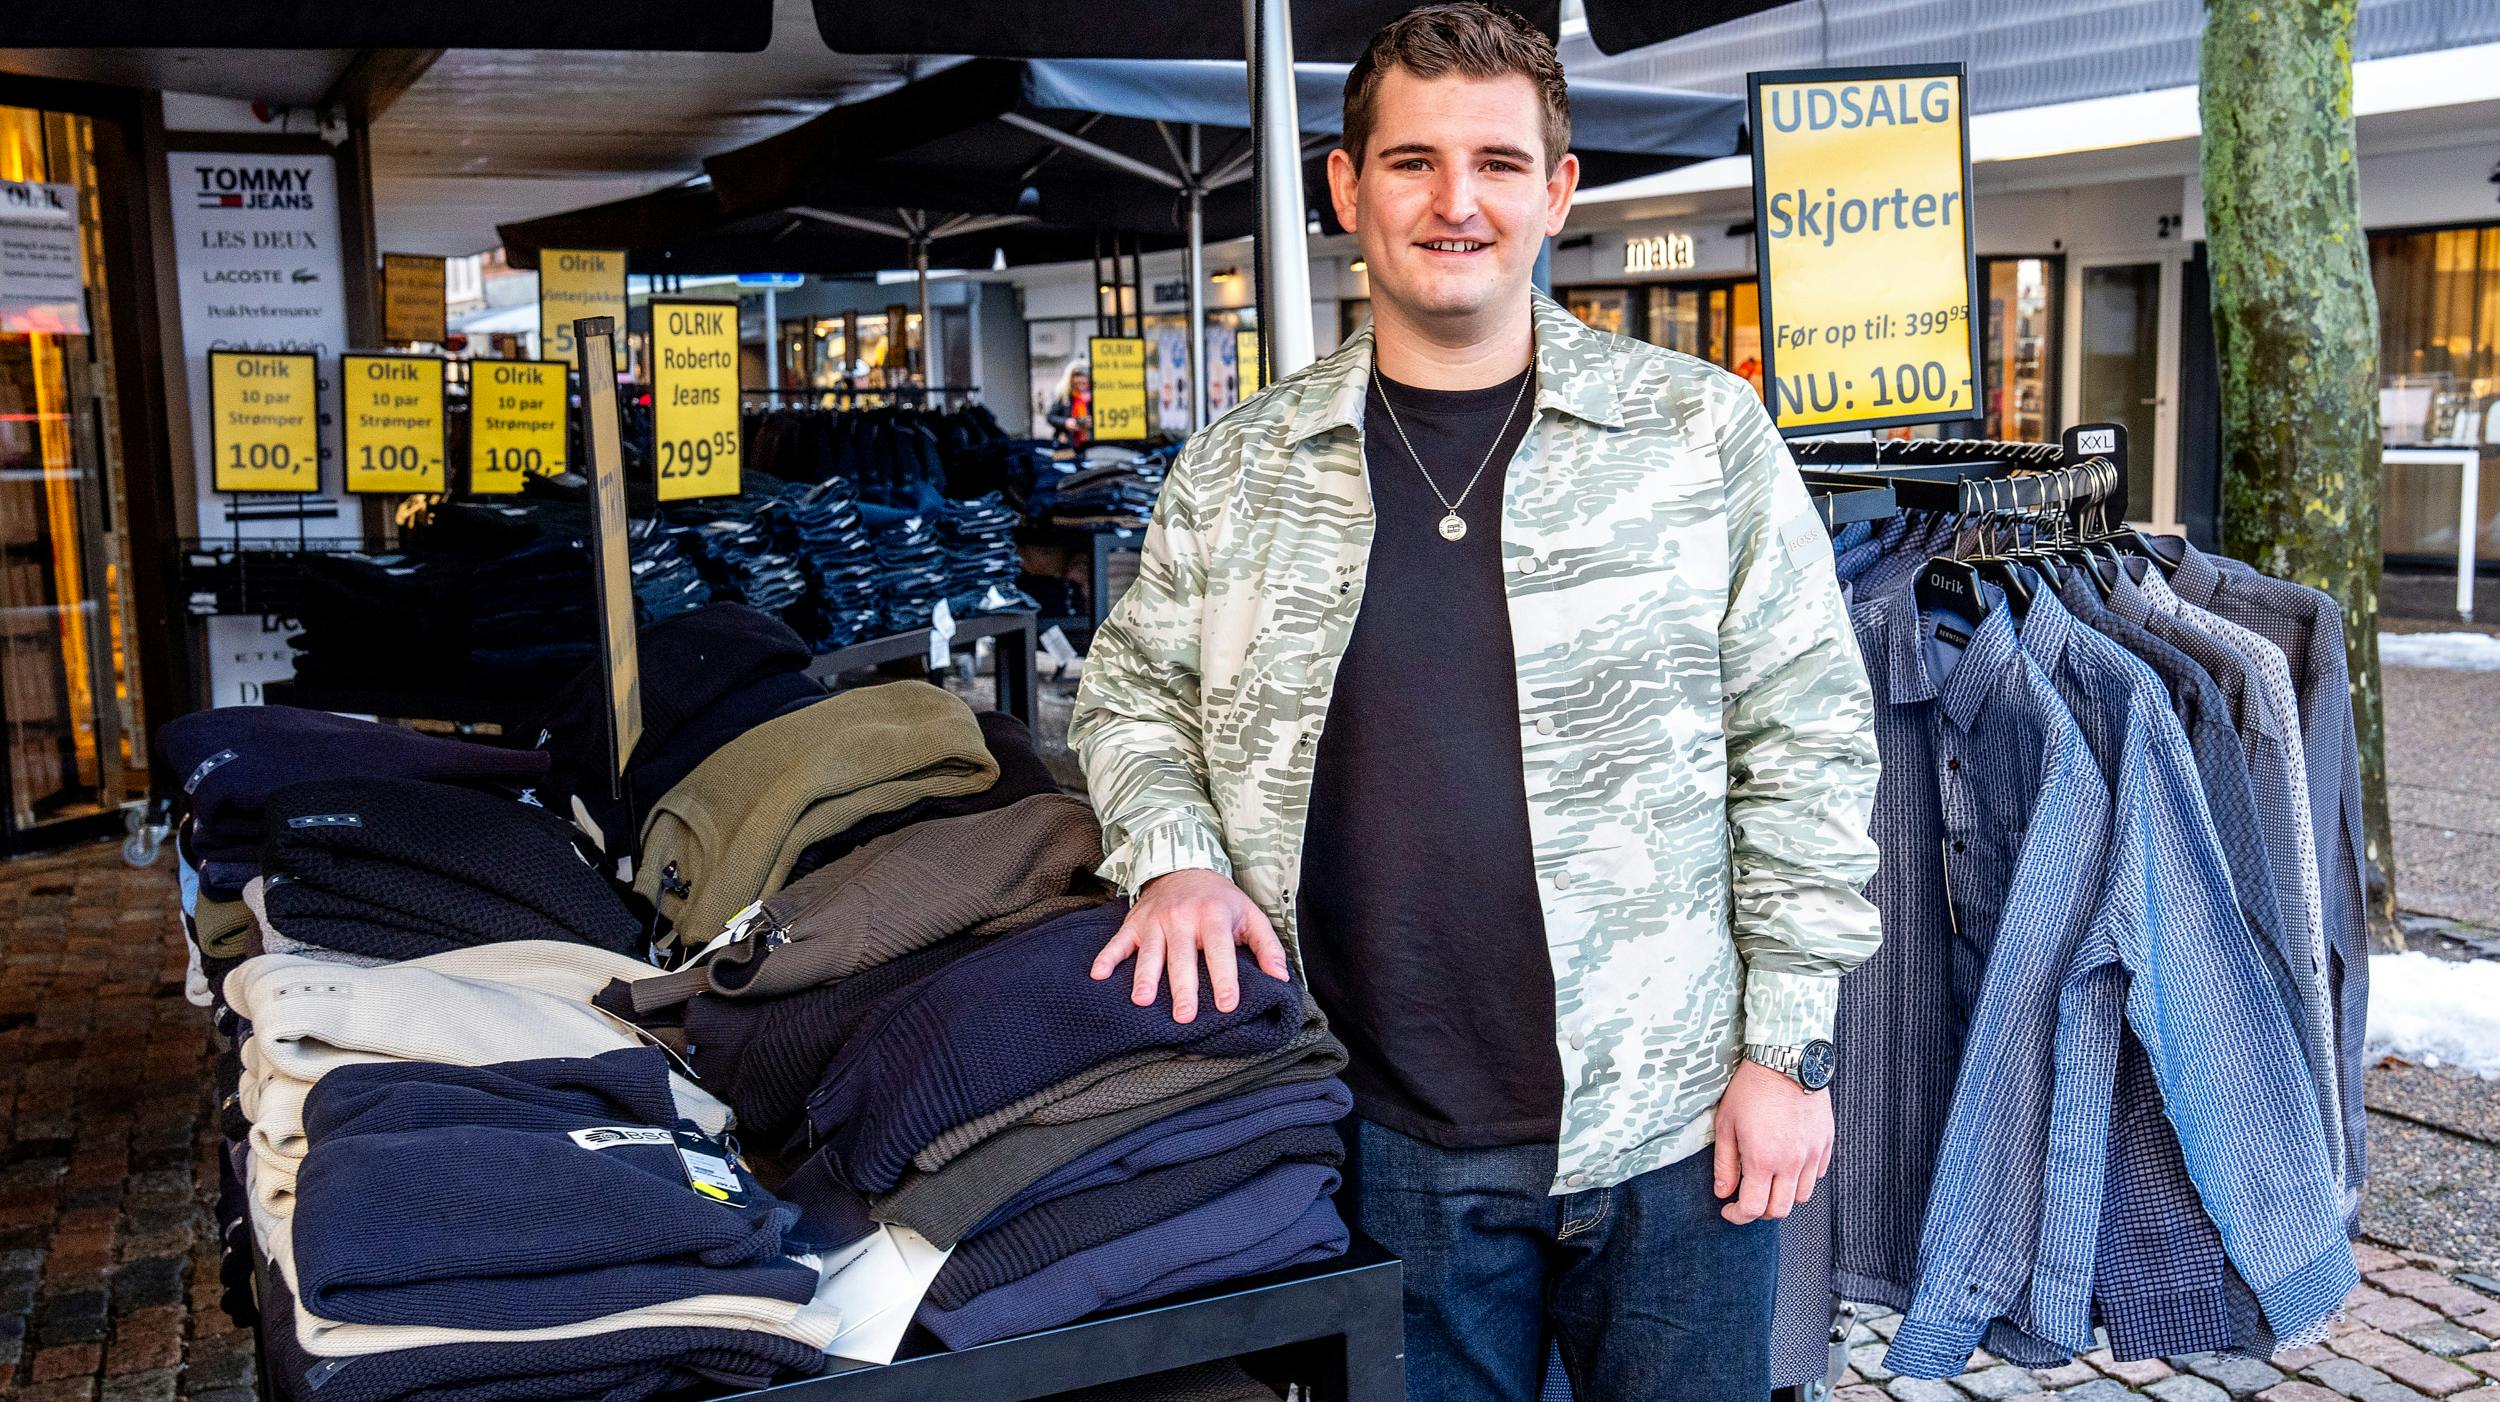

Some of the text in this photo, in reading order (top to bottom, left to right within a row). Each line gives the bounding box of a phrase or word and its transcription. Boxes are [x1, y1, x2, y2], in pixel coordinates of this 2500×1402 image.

[1771, 80, 1950, 133] UDSALG
[196, 166, 312, 191] TOMMY
[246, 193, 315, 210] JEANS
[1769, 187, 1959, 247] Skjorter
[202, 230, 318, 250] LES DEUX
[1624, 232, 1695, 273] mata
[559, 253, 606, 273] Olrik
[202, 269, 284, 284] LACOSTE
[668, 311, 724, 337] OLRIK
[1777, 323, 1818, 350] Før
[1825, 323, 1857, 349] op
[1864, 313, 1897, 341] til:
[663, 345, 732, 370] Roberto
[235, 359, 290, 379] Olrik
[367, 362, 419, 381] Olrik
[494, 366, 543, 385] Olrik
[241, 390, 291, 406] 10 par
[672, 383, 721, 407] Jeans
[1776, 360, 1973, 416] NU: 100,-
[372, 393, 419, 408] 10 par
[498, 396, 544, 412] 10 par
[228, 410, 304, 428] Strømper
[360, 412, 433, 429] Strømper
[485, 416, 555, 433] Strømper
[2080, 435, 2114, 450] XXL
[229, 442, 314, 476] 100,-
[360, 443, 443, 477] 100,-
[1788, 527, 1819, 553] BOSS
[1930, 572, 1964, 595] Olrik
